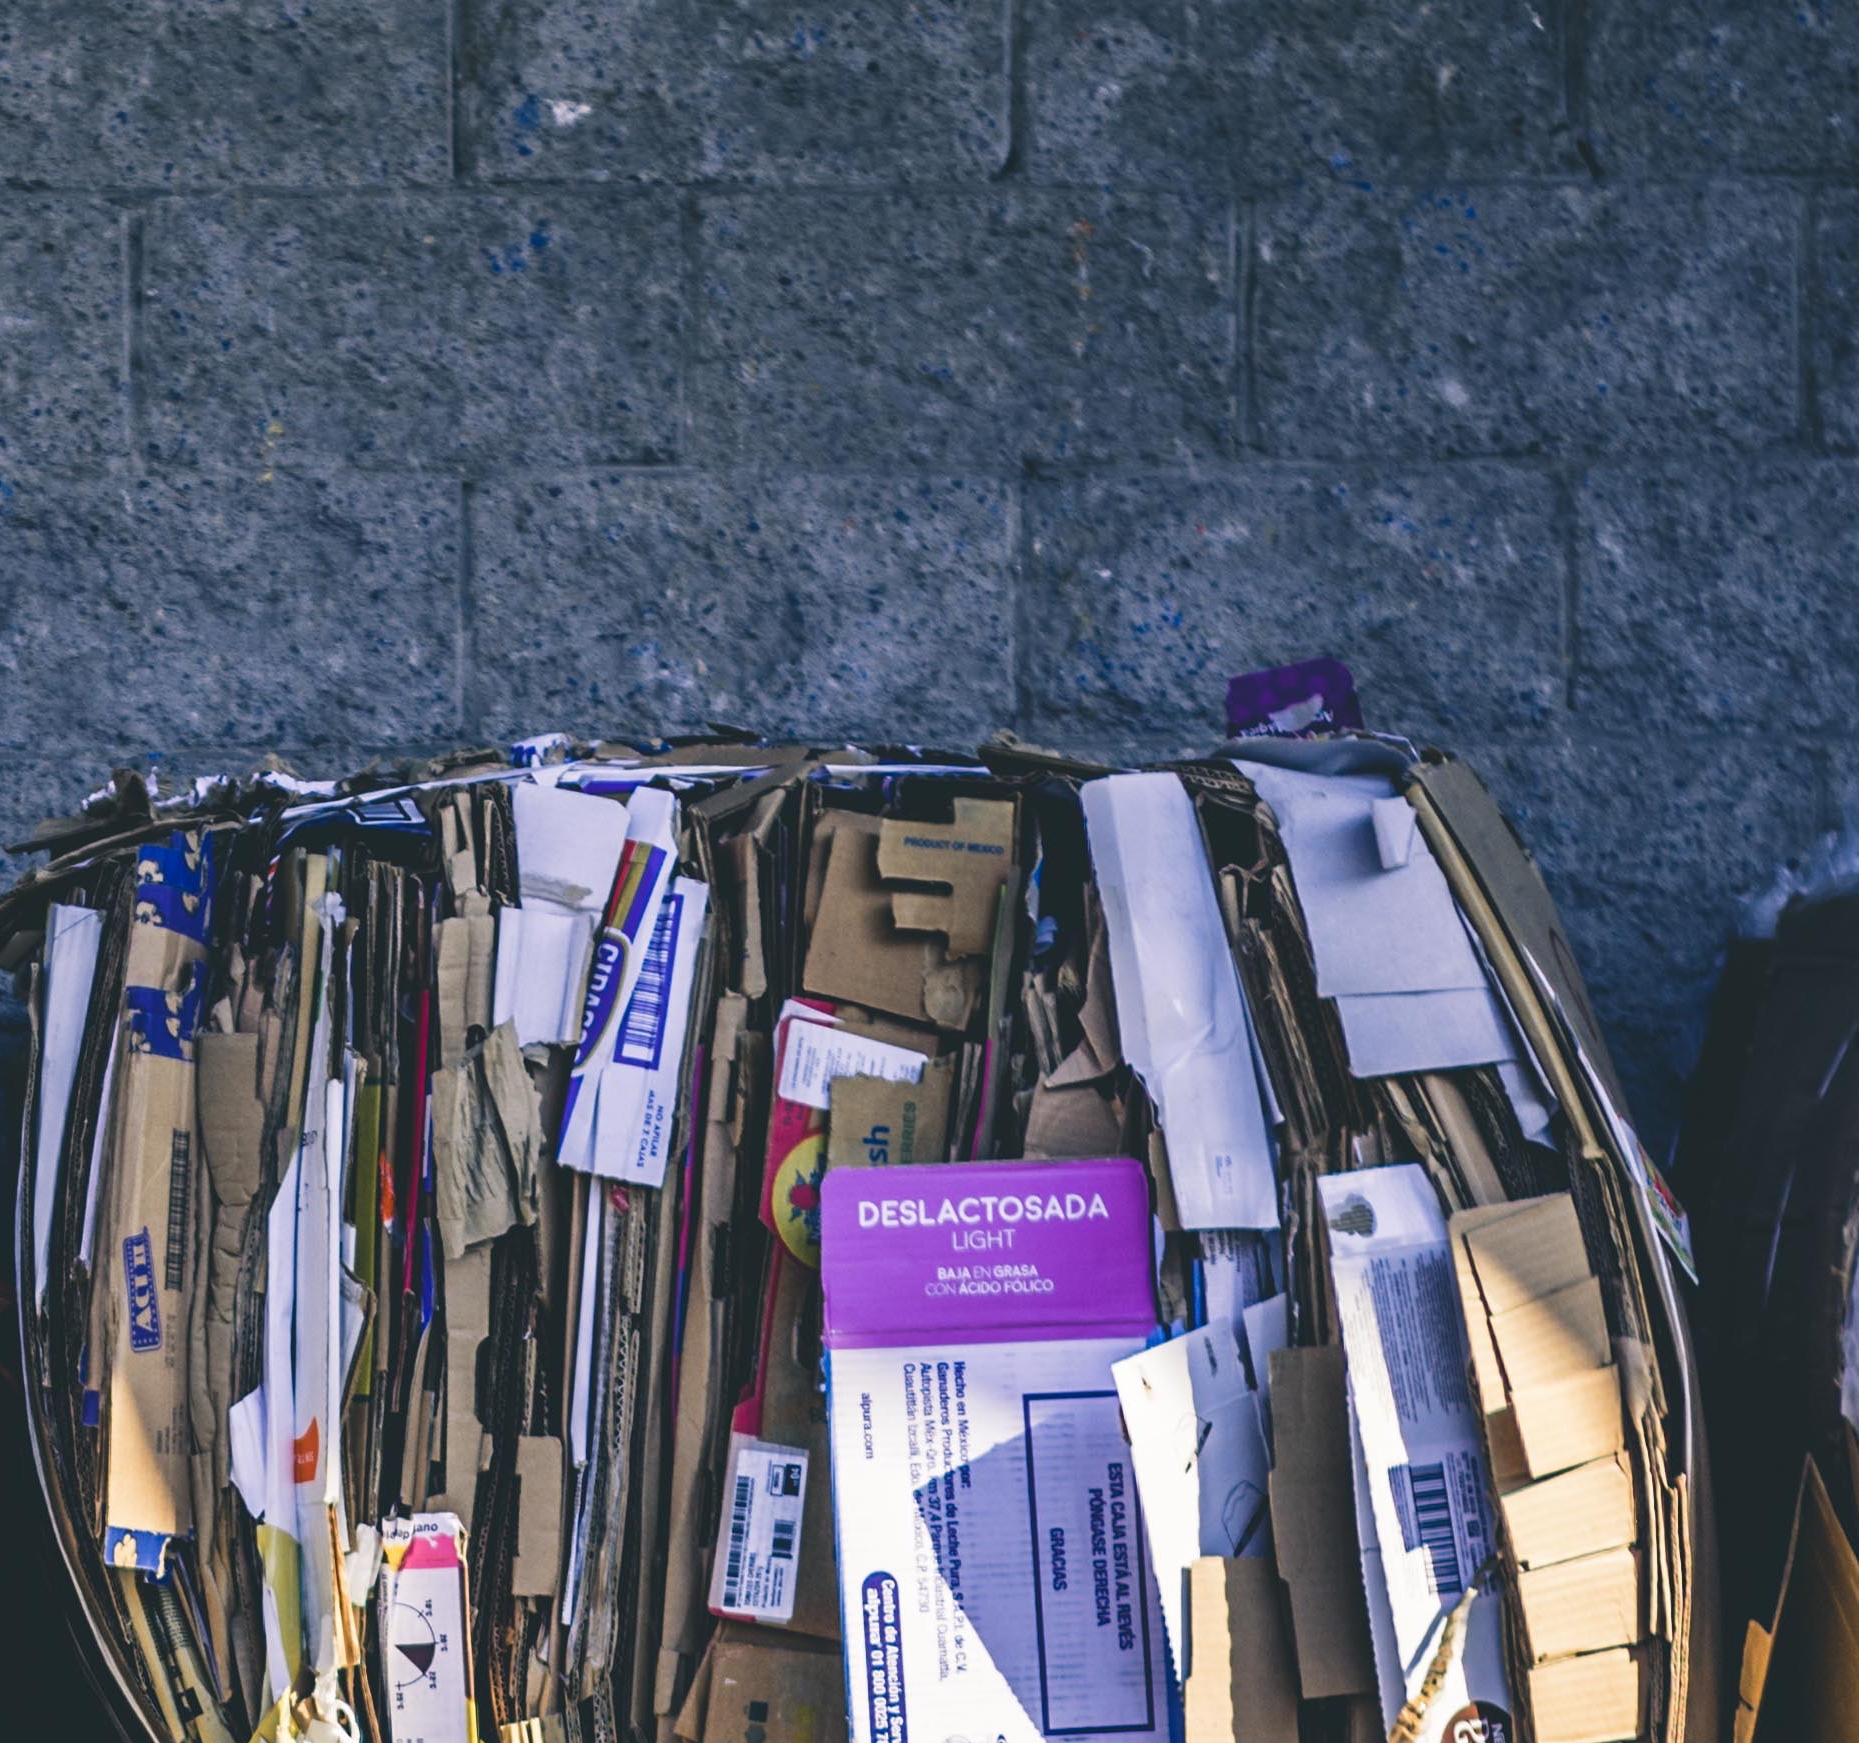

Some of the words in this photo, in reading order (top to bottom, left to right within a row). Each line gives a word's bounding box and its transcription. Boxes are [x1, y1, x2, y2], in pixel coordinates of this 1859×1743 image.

[902, 836, 949, 851] PRODUCT
[951, 840, 965, 851] OF
[967, 841, 1004, 856] MEXICO
[652, 1122, 662, 1158] APILAR
[899, 1101, 917, 1164] ERRIES
[858, 1193, 1110, 1229] DESLACTOSADA
[952, 1228, 1016, 1252] LIGHT
[925, 1281, 957, 1296] CON
[958, 1276, 1003, 1295] ÁCIDO
[1004, 1275, 1055, 1294] FÓLICO
[937, 1266, 972, 1281] BAJA
[973, 1266, 991, 1280] EN
[993, 1264, 1039, 1280] GRASA
[133, 1273, 154, 1331] ACT
[903, 1363, 916, 1422] Cuautitlán
[936, 1362, 950, 1425] Ganaderos
[953, 1361, 965, 1399] Hecho
[862, 1392, 874, 1460] alpura.com
[956, 1402, 966, 1417] en
[906, 1424, 919, 1460] Izcalli,
[957, 1419, 970, 1464] México
[909, 1462, 923, 1487] Edo.
[920, 1363, 933, 1417] Autopista
[931, 1523, 944, 1563] Parque
[940, 1427, 956, 1503] Productores
[960, 1464, 972, 1488] por:
[1107, 1462, 1124, 1499] ESTA
[912, 1488, 923, 1504] de
[946, 1502, 958, 1515] de
[946, 1516, 960, 1550] Leche
[1088, 1487, 1108, 1556] PÓNGASE
[1110, 1501, 1126, 1540] CAJA
[948, 1551, 962, 1591] Pura,
[1049, 1526, 1068, 1592] GRACIAS
[1113, 1543, 1132, 1580] ESTÁ
[882, 1580, 895, 1623] Centro
[1092, 1559, 1111, 1627] DERECHA
[1115, 1582, 1130, 1601] AL
[864, 1588, 881, 1645] alpura
[885, 1626, 897, 1643] de
[1117, 1604, 1136, 1651] REVÉS
[872, 1650, 884, 1666] 01
[955, 1634, 965, 1647] de
[886, 1645, 902, 1702] Atención
[956, 1650, 968, 1674] C.V.
[872, 1670, 887, 1694] 800
